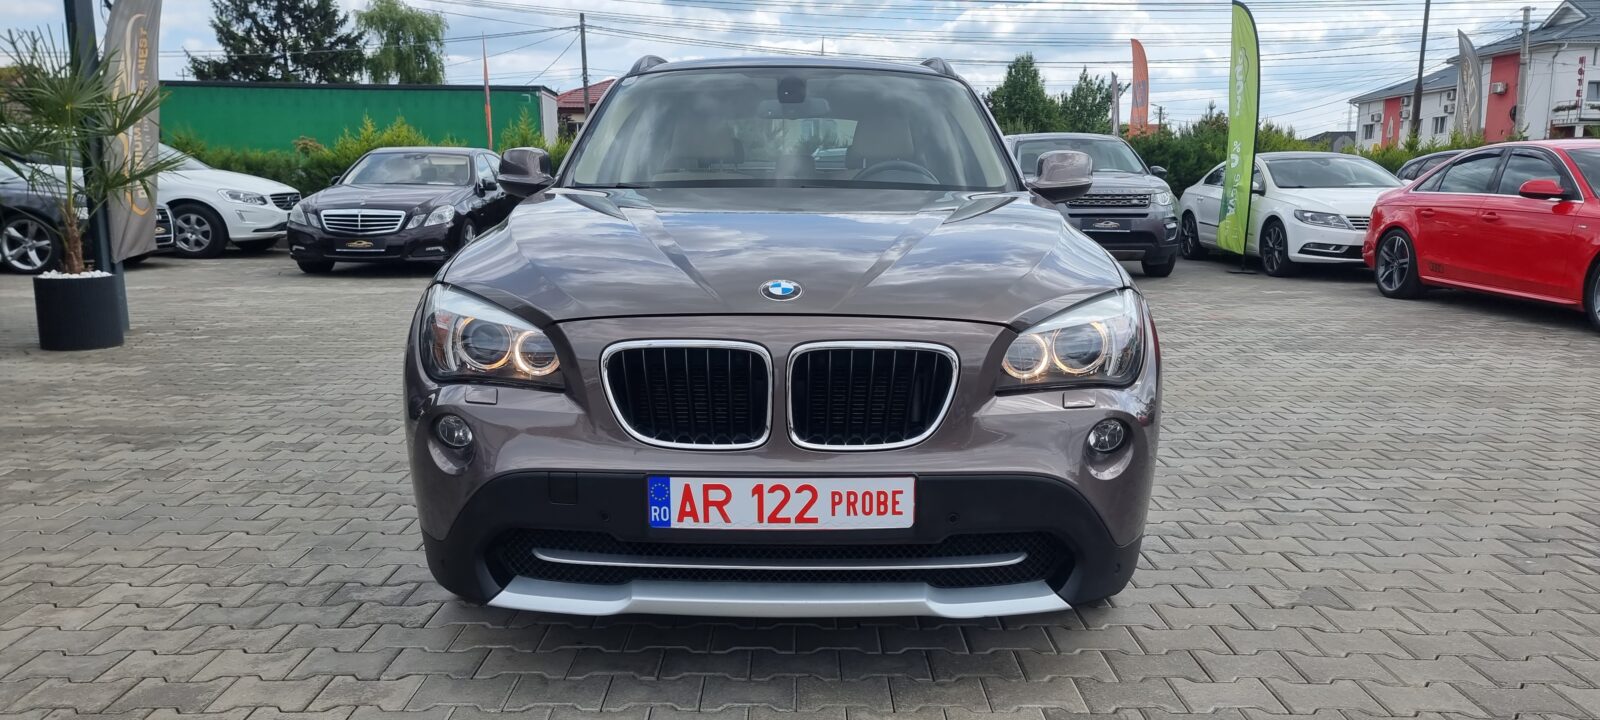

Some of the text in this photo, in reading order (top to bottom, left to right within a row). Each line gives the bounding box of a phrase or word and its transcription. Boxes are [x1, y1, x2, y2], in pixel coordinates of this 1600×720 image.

[1576, 55, 1586, 108] HOTEL
[133, 127, 148, 199] PMIUM
[651, 505, 670, 522] RO
[676, 483, 904, 524] AR 122 PROBE
